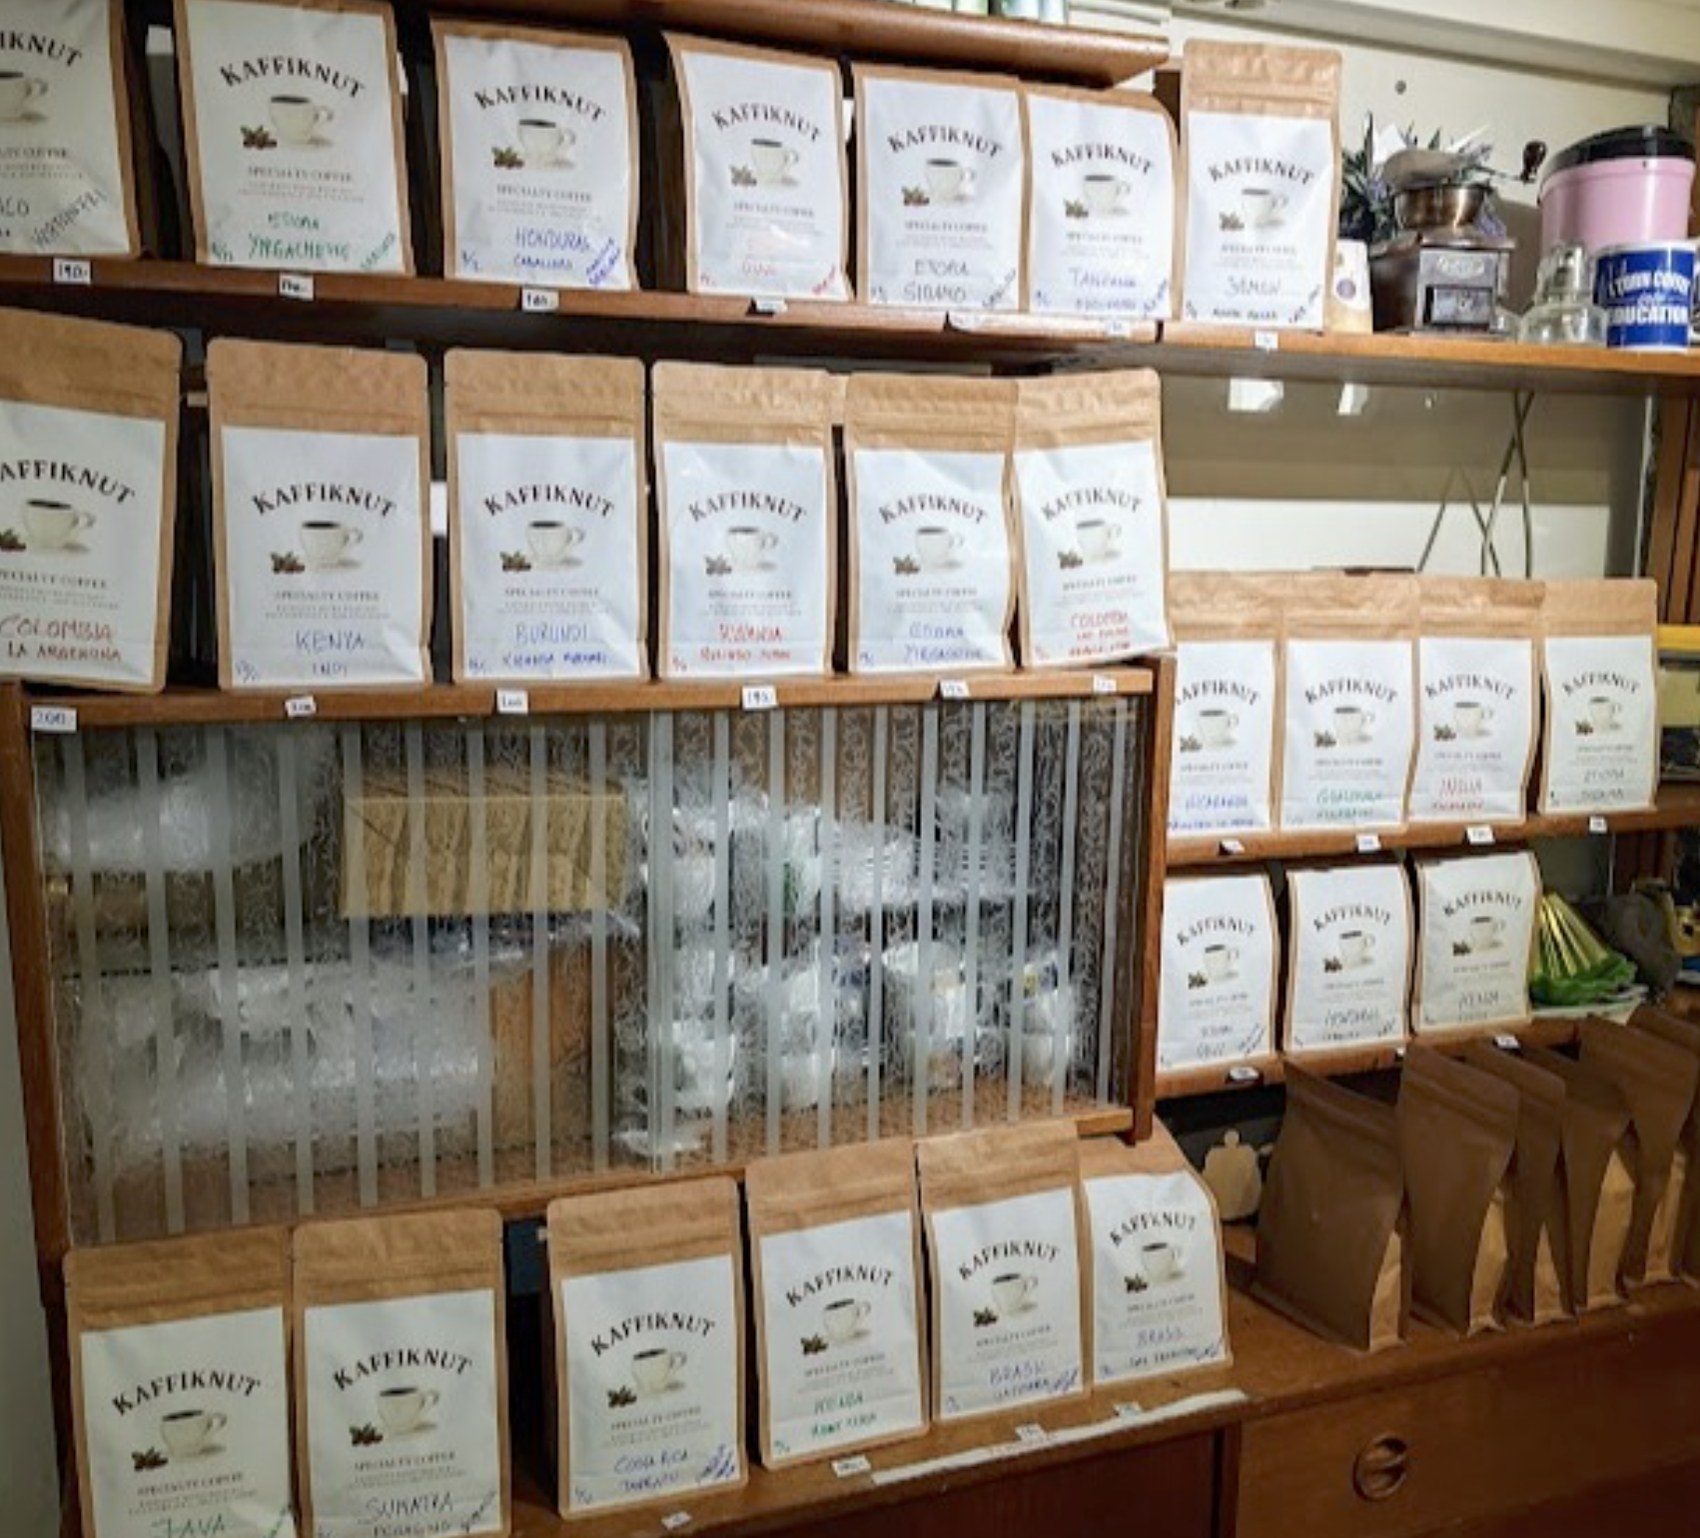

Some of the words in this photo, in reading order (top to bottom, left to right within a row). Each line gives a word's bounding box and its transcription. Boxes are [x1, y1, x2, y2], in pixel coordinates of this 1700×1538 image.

[219, 55, 365, 99] KAFFIKNUT
[474, 82, 606, 123] KAFFIKNUT
[711, 101, 822, 142] KAFFIKNUT
[887, 124, 1004, 160] KAFFIKNUT
[1049, 140, 1156, 177] KAFFIKNUT
[1207, 157, 1316, 187] KAFFIKNUT
[251, 482, 398, 517] KAFFIKNUT
[483, 483, 615, 518] KAFFIKNUT
[688, 490, 807, 523] KAFFIKNUT
[879, 492, 988, 525] KAFFIKNUT
[1041, 486, 1144, 521] KAFFIKNUT
[295, 629, 365, 654] KENYA
[1304, 678, 1398, 705] KAFFIKNUT
[1425, 672, 1518, 700] KAFFIKNUT
[1562, 672, 1641, 697] KAFFIKNUT
[1312, 902, 1391, 932] KAFFIKNUT
[1443, 889, 1523, 917] KAFFIKNUT
[1175, 916, 1256, 946] KAFFIKNUT
[1109, 1210, 1197, 1247] KAFFIKNUT
[958, 1239, 1060, 1281] KAFFIKNUT
[785, 1264, 895, 1308] KAFFIKNUT
[590, 1311, 717, 1358] KAFFIKNUT
[332, 1349, 474, 1391] KAFFIKNUT
[111, 1369, 262, 1415] KAFFIKNUT
